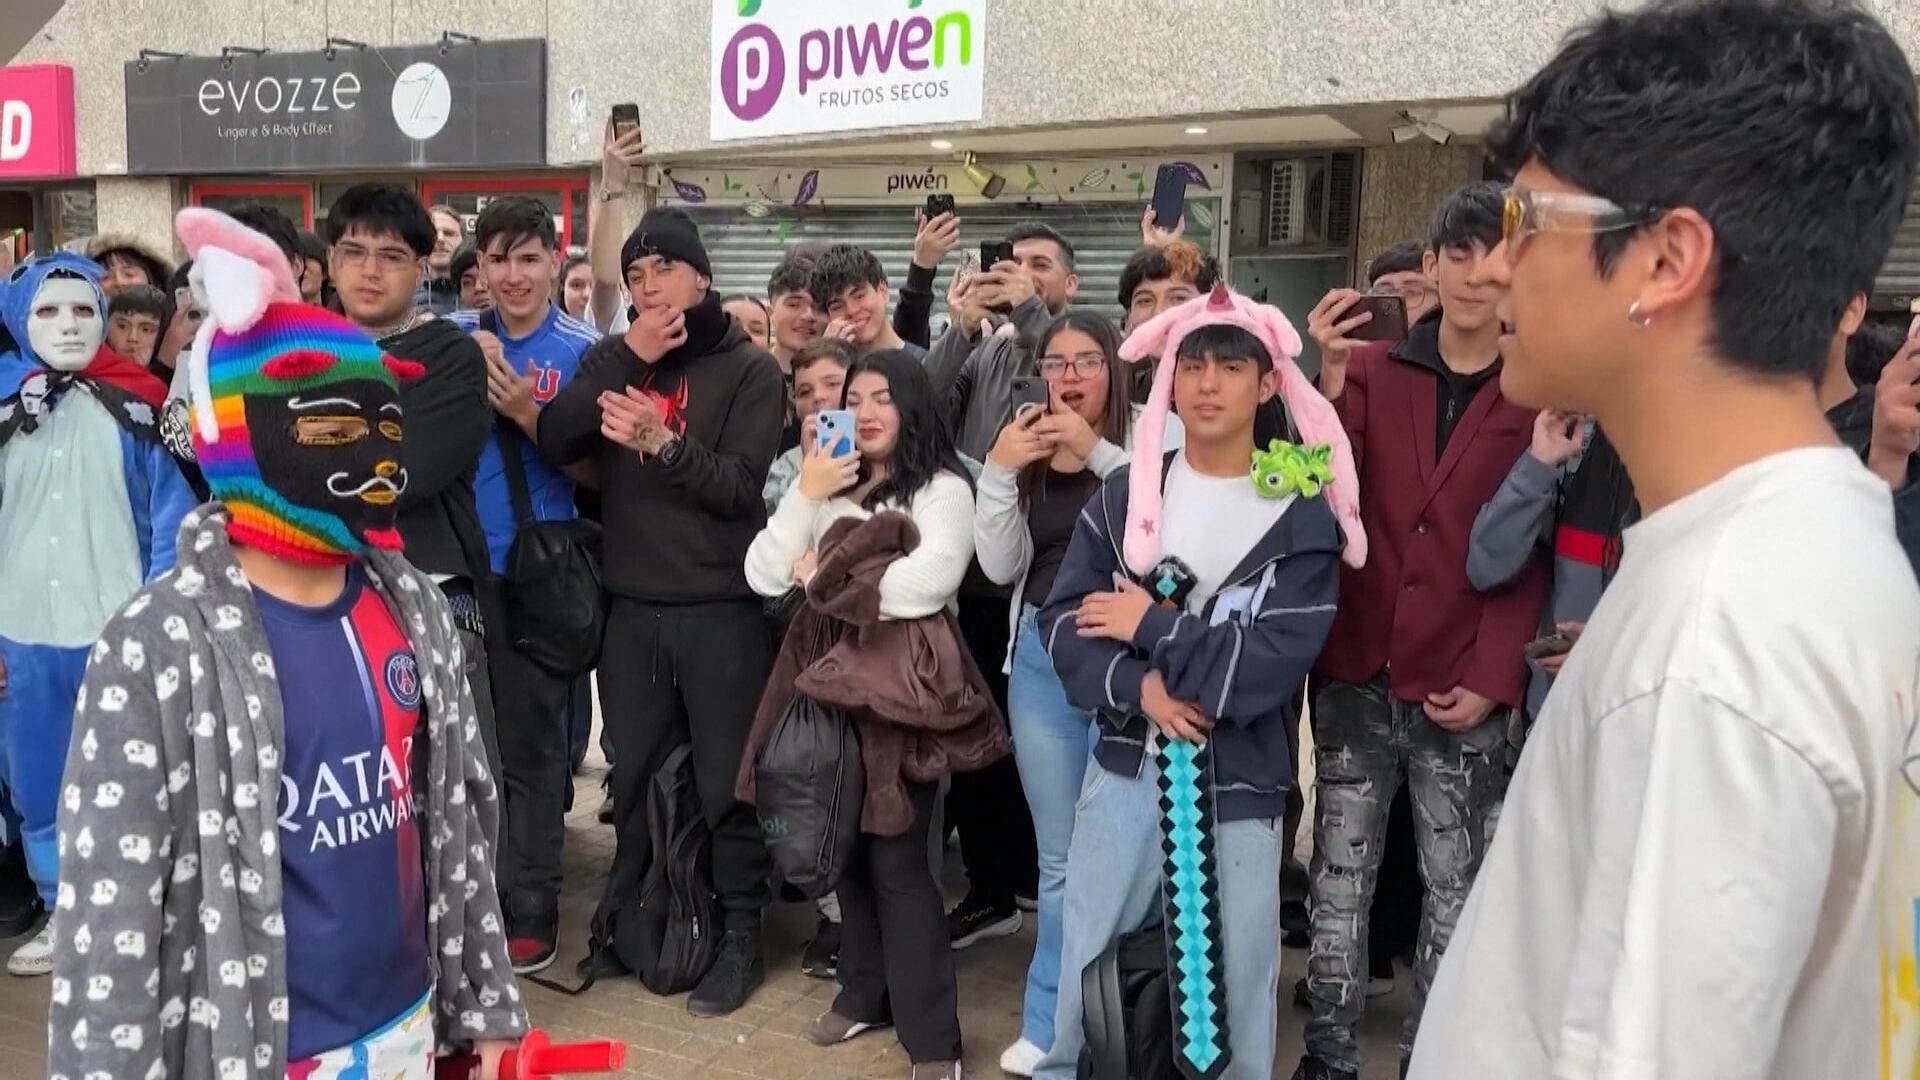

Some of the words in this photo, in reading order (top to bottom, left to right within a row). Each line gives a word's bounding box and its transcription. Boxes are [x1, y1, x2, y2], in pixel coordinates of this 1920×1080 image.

[198, 72, 362, 116] evozze
[818, 86, 884, 110] FRUTOS
[889, 79, 949, 100] SECOS
[217, 125, 259, 141] Lingerie
[261, 123, 270, 137] &
[272, 122, 300, 138] Body
[302, 121, 333, 136] Effect
[887, 165, 948, 194] piwén
